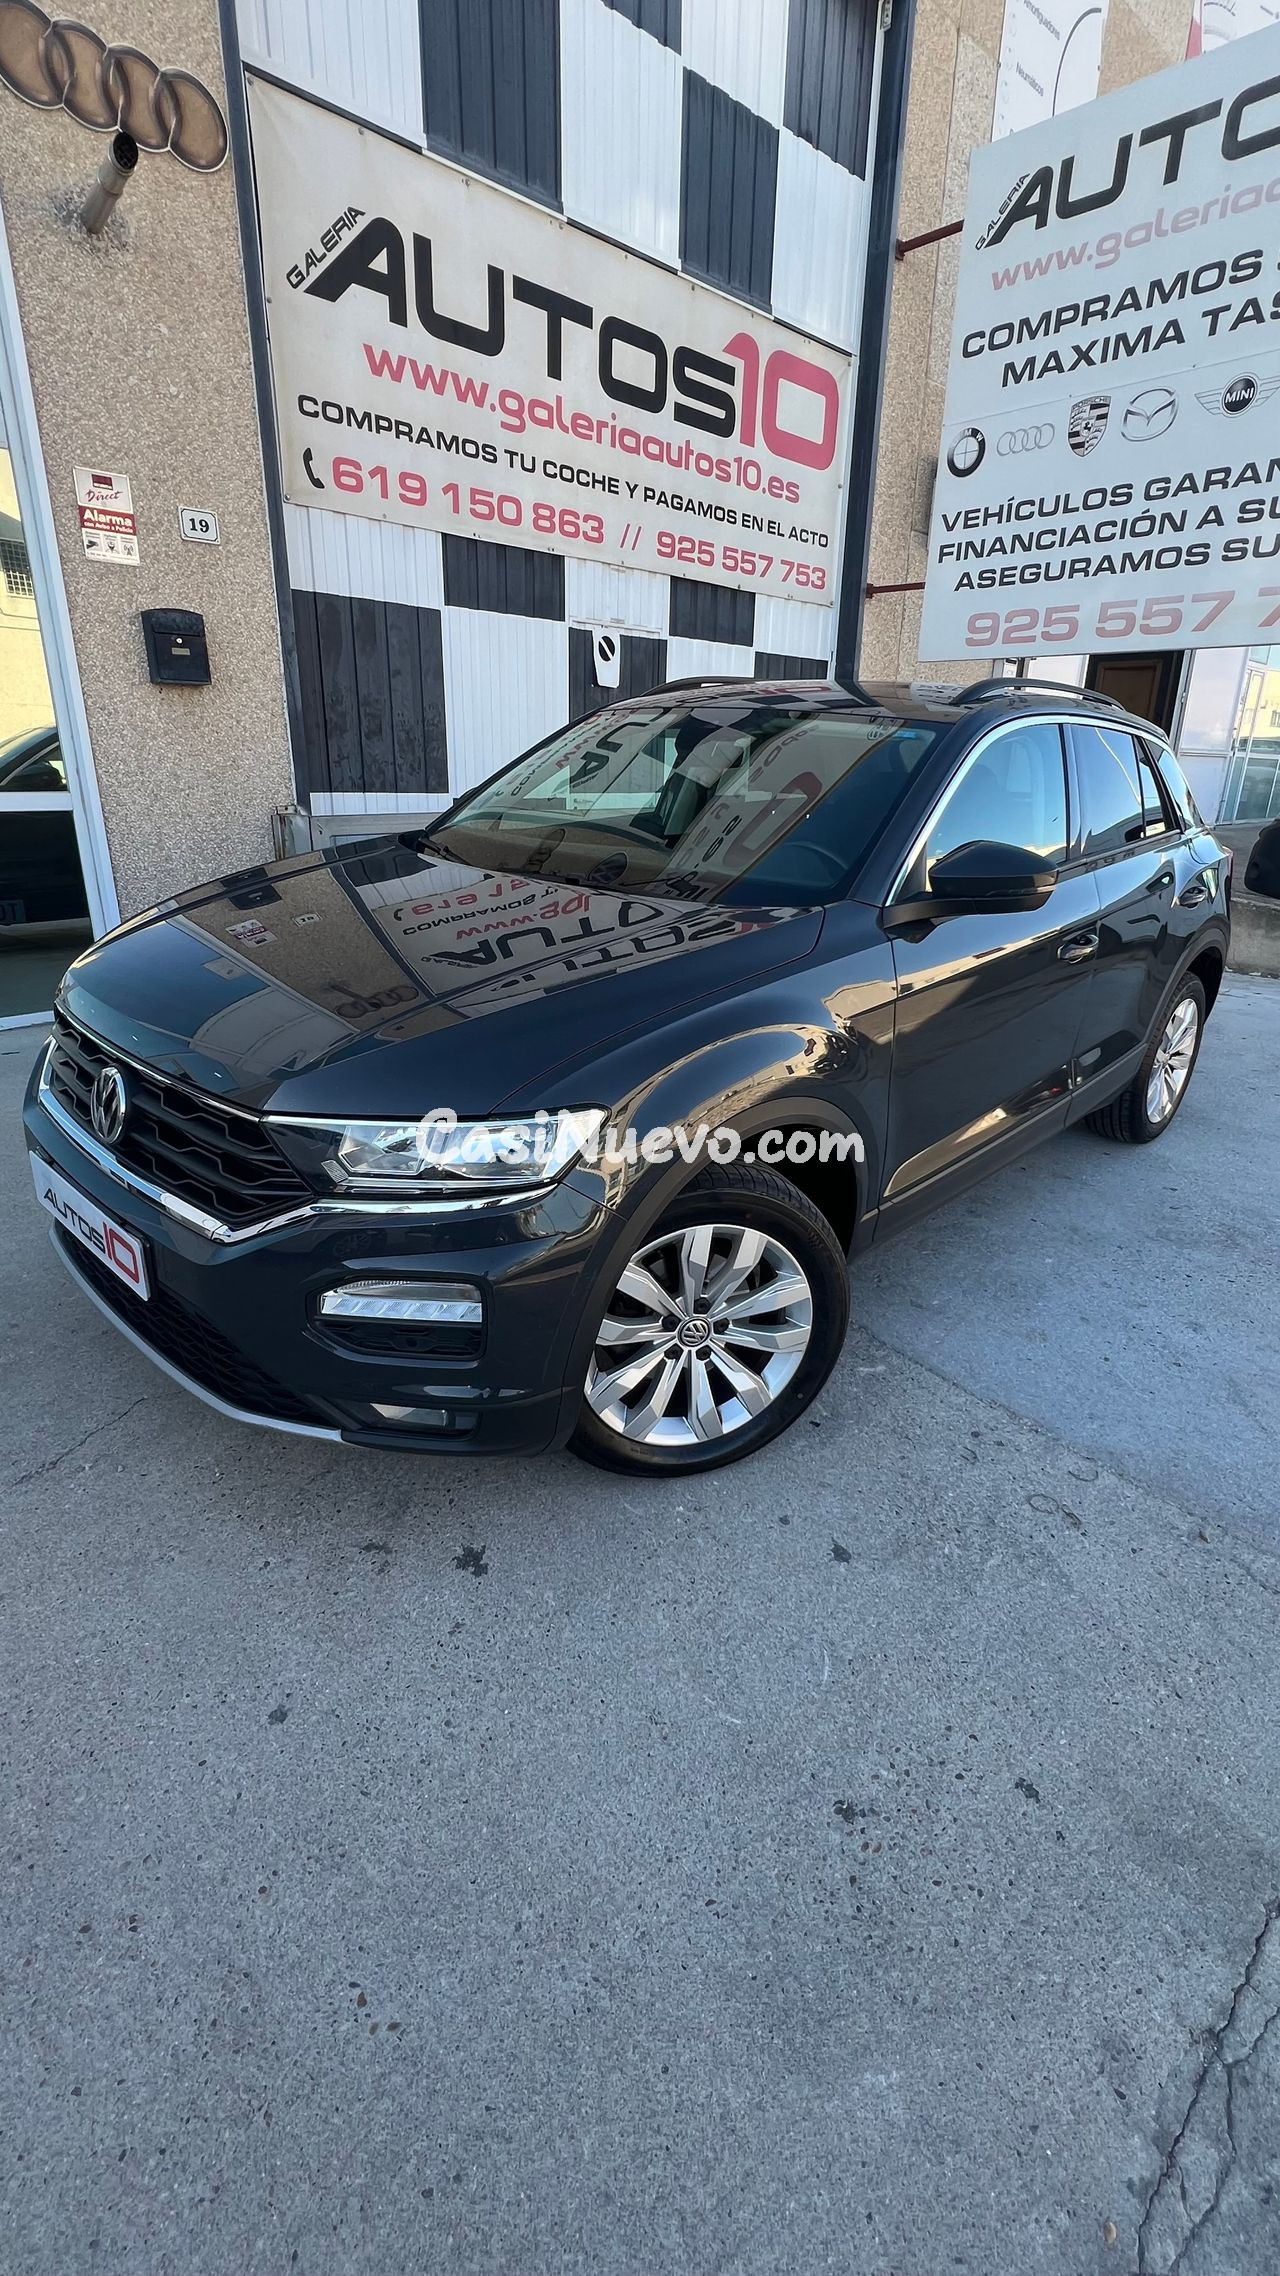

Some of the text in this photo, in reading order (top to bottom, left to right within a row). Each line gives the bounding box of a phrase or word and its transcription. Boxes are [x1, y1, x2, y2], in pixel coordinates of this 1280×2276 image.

[975, 173, 1030, 250] GALERIA
[286, 206, 366, 289] GALERIA
[962, 249, 1264, 358] COMPRAMOS
[1001, 318, 1186, 388] MAXIMA
[363, 343, 800, 503] www.galeriaautos10.es
[1225, 387, 1254, 403] MINI
[86, 489, 123, 502] Direct
[298, 394, 829, 548] COMPRAMOS TU COCHE Y PAGAMOS EN EL ACTO
[83, 509, 132, 526] Alarma
[189, 517, 209, 534] 19
[332, 456, 428, 507] 619
[441, 482, 523, 527] 150
[532, 502, 604, 544] 863
[656, 531, 715, 567] 925
[722, 545, 774, 578] 557
[780, 559, 827, 590] 753
[938, 508, 1188, 563] FINANCIACIÓN
[1195, 504, 1225, 530] A
[941, 482, 1133, 532] VEHÍCULOS
[954, 534, 1280, 591] ASEGURAMOS SU
[965, 605, 1080, 647] 925
[1095, 590, 1236, 639] 557
